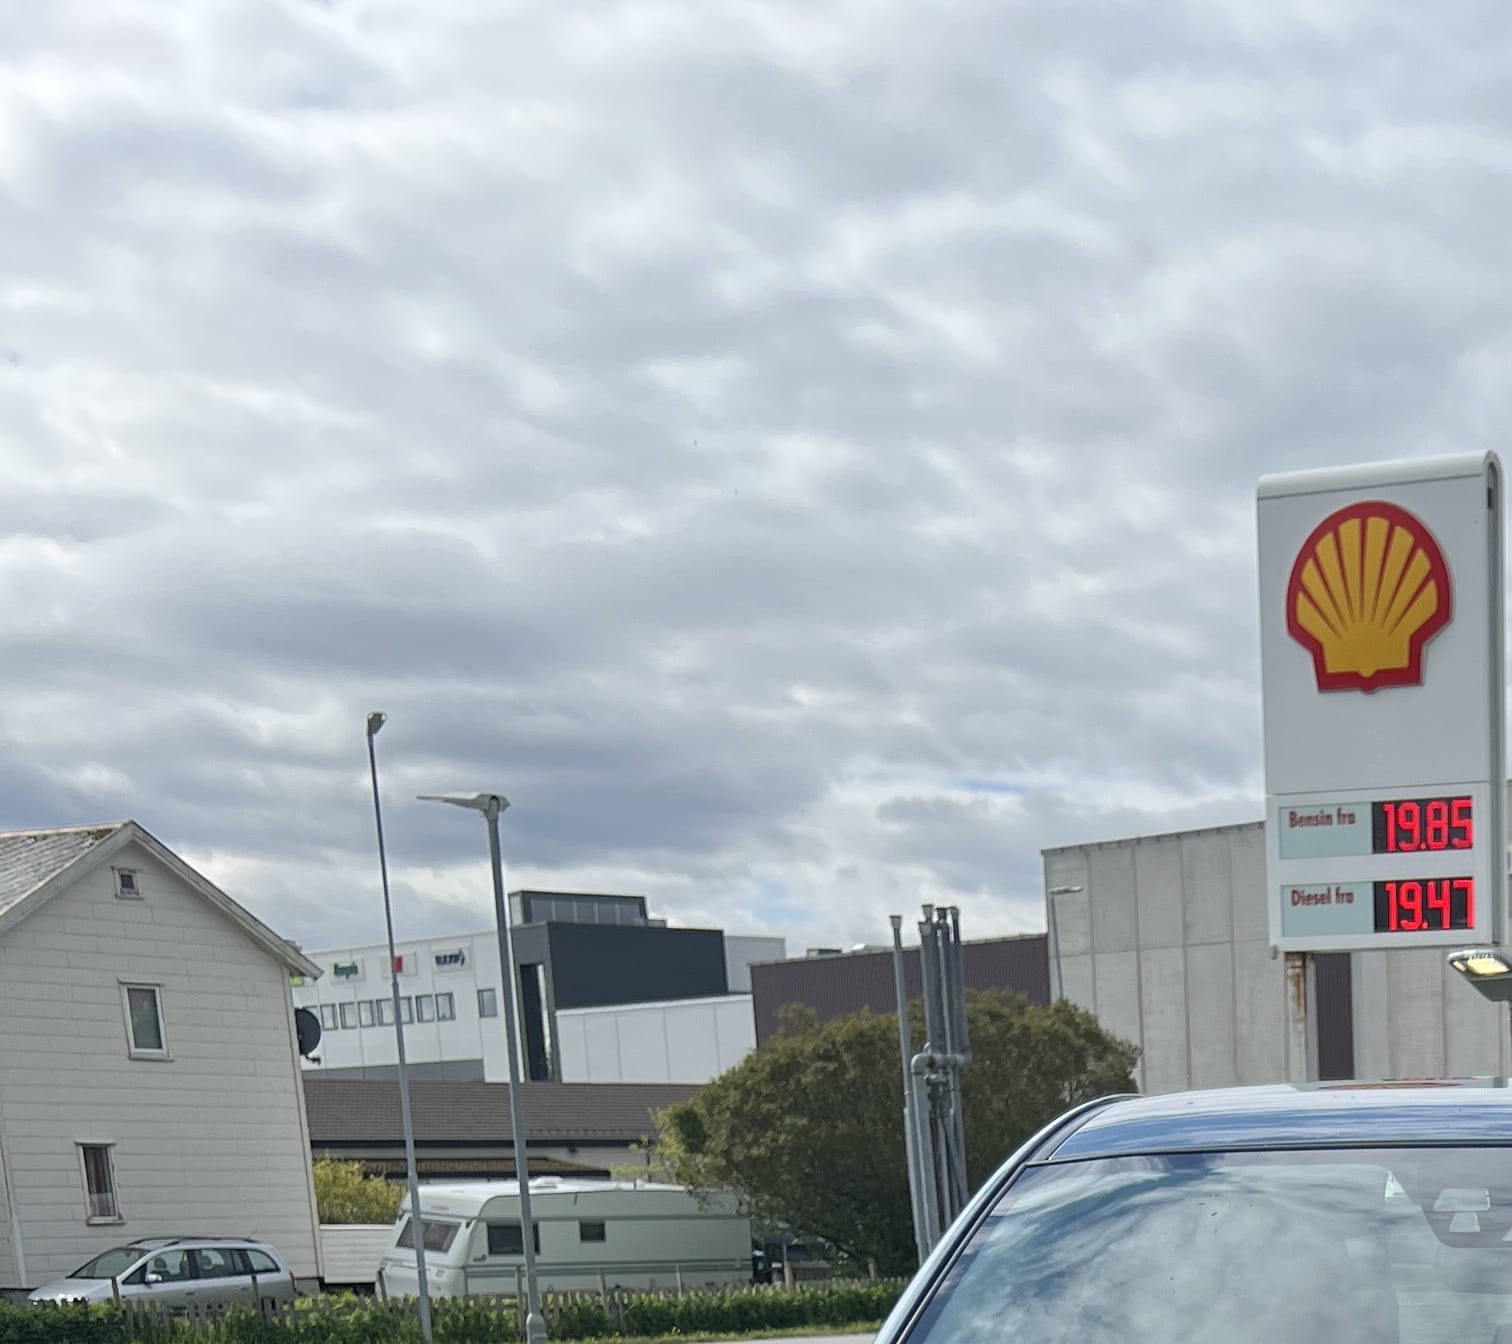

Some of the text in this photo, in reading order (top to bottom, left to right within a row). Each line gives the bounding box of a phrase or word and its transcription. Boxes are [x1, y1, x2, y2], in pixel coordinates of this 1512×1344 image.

[1289, 798, 1473, 853] Bensin fra 19.85
[1291, 878, 1475, 931] Diesel fra 19.47
